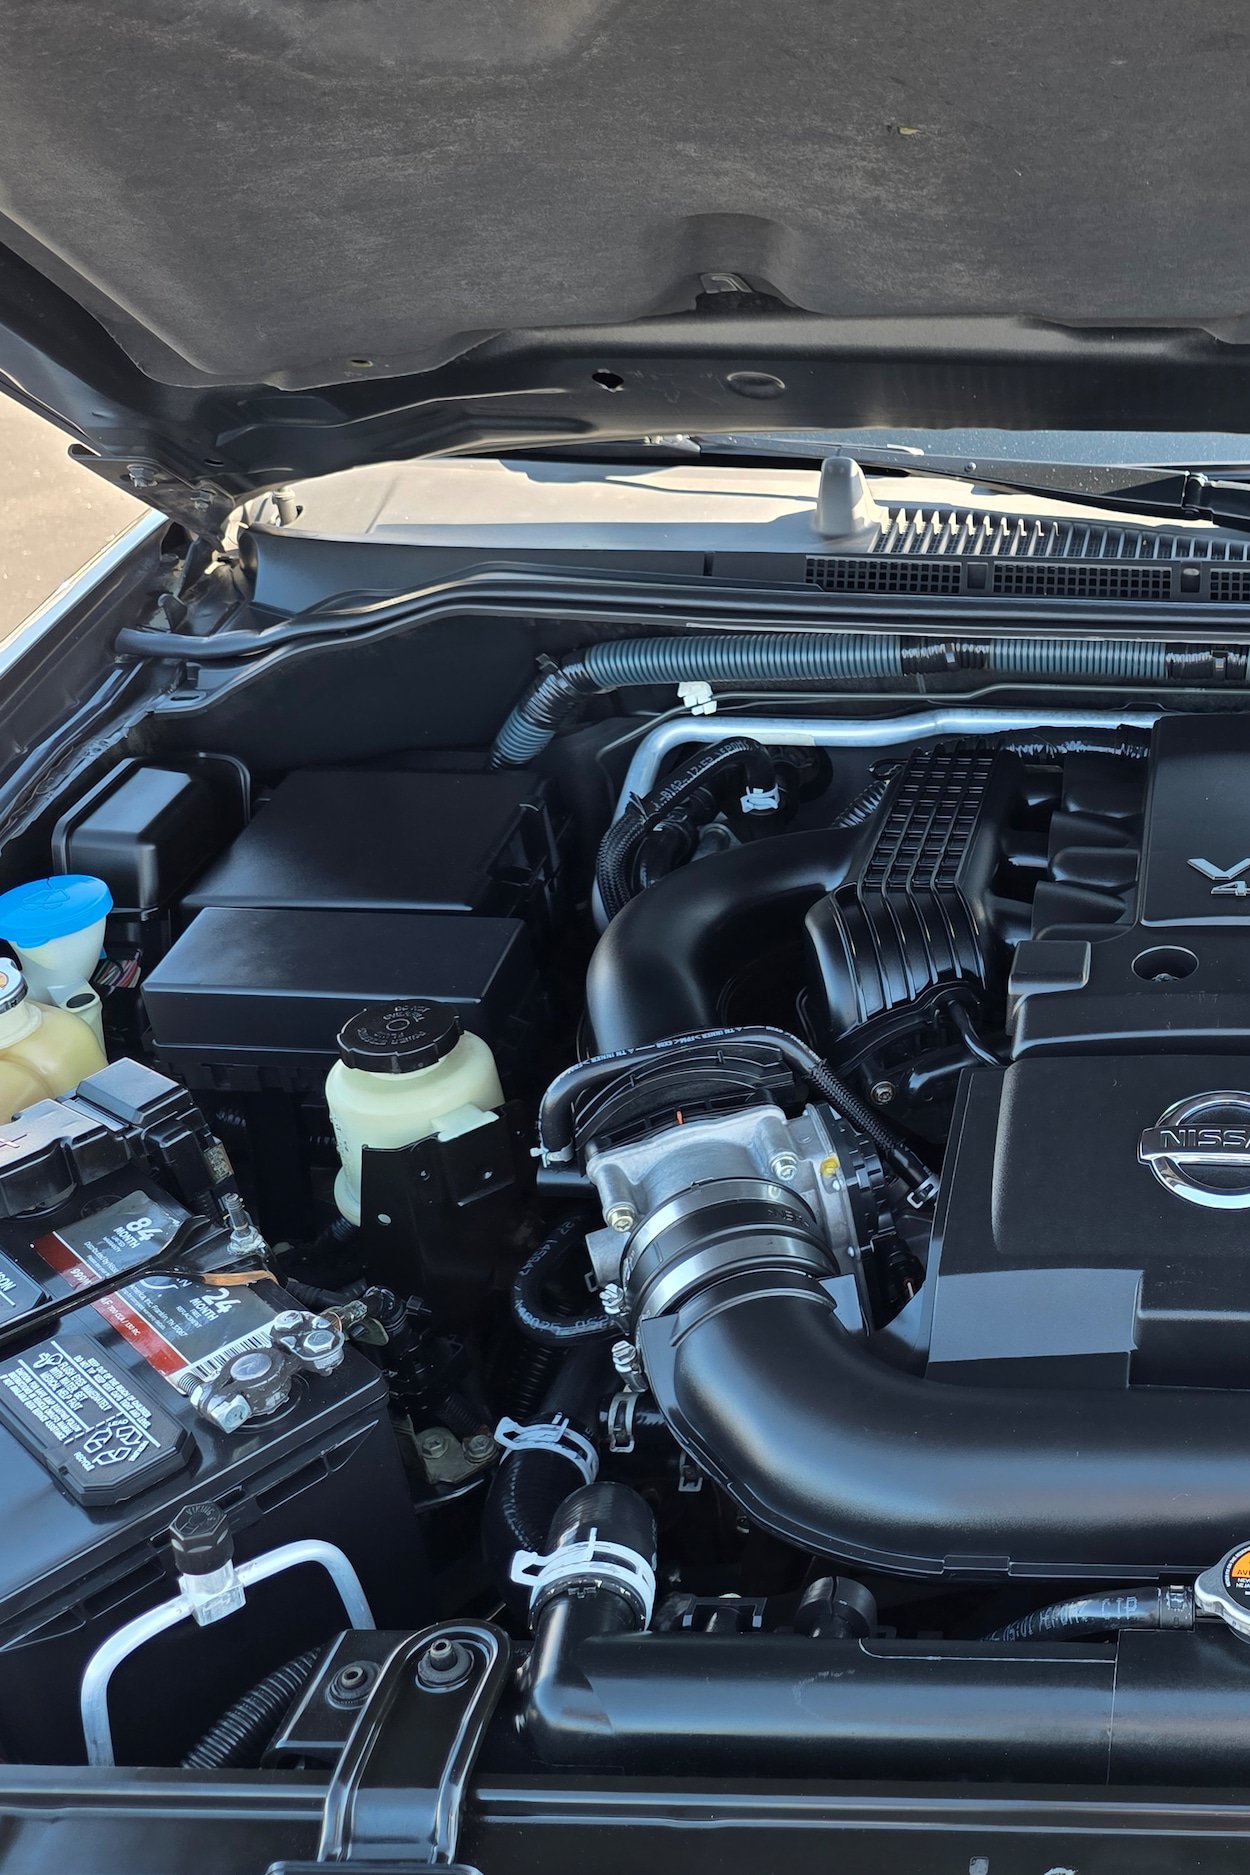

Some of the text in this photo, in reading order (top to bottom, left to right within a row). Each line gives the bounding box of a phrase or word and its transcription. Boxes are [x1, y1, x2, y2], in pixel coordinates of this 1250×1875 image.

[112, 1225, 140, 1249] MONTH
[124, 1214, 163, 1243] 84
[188, 1295, 219, 1322] MONTH
[201, 1285, 242, 1316] 24
